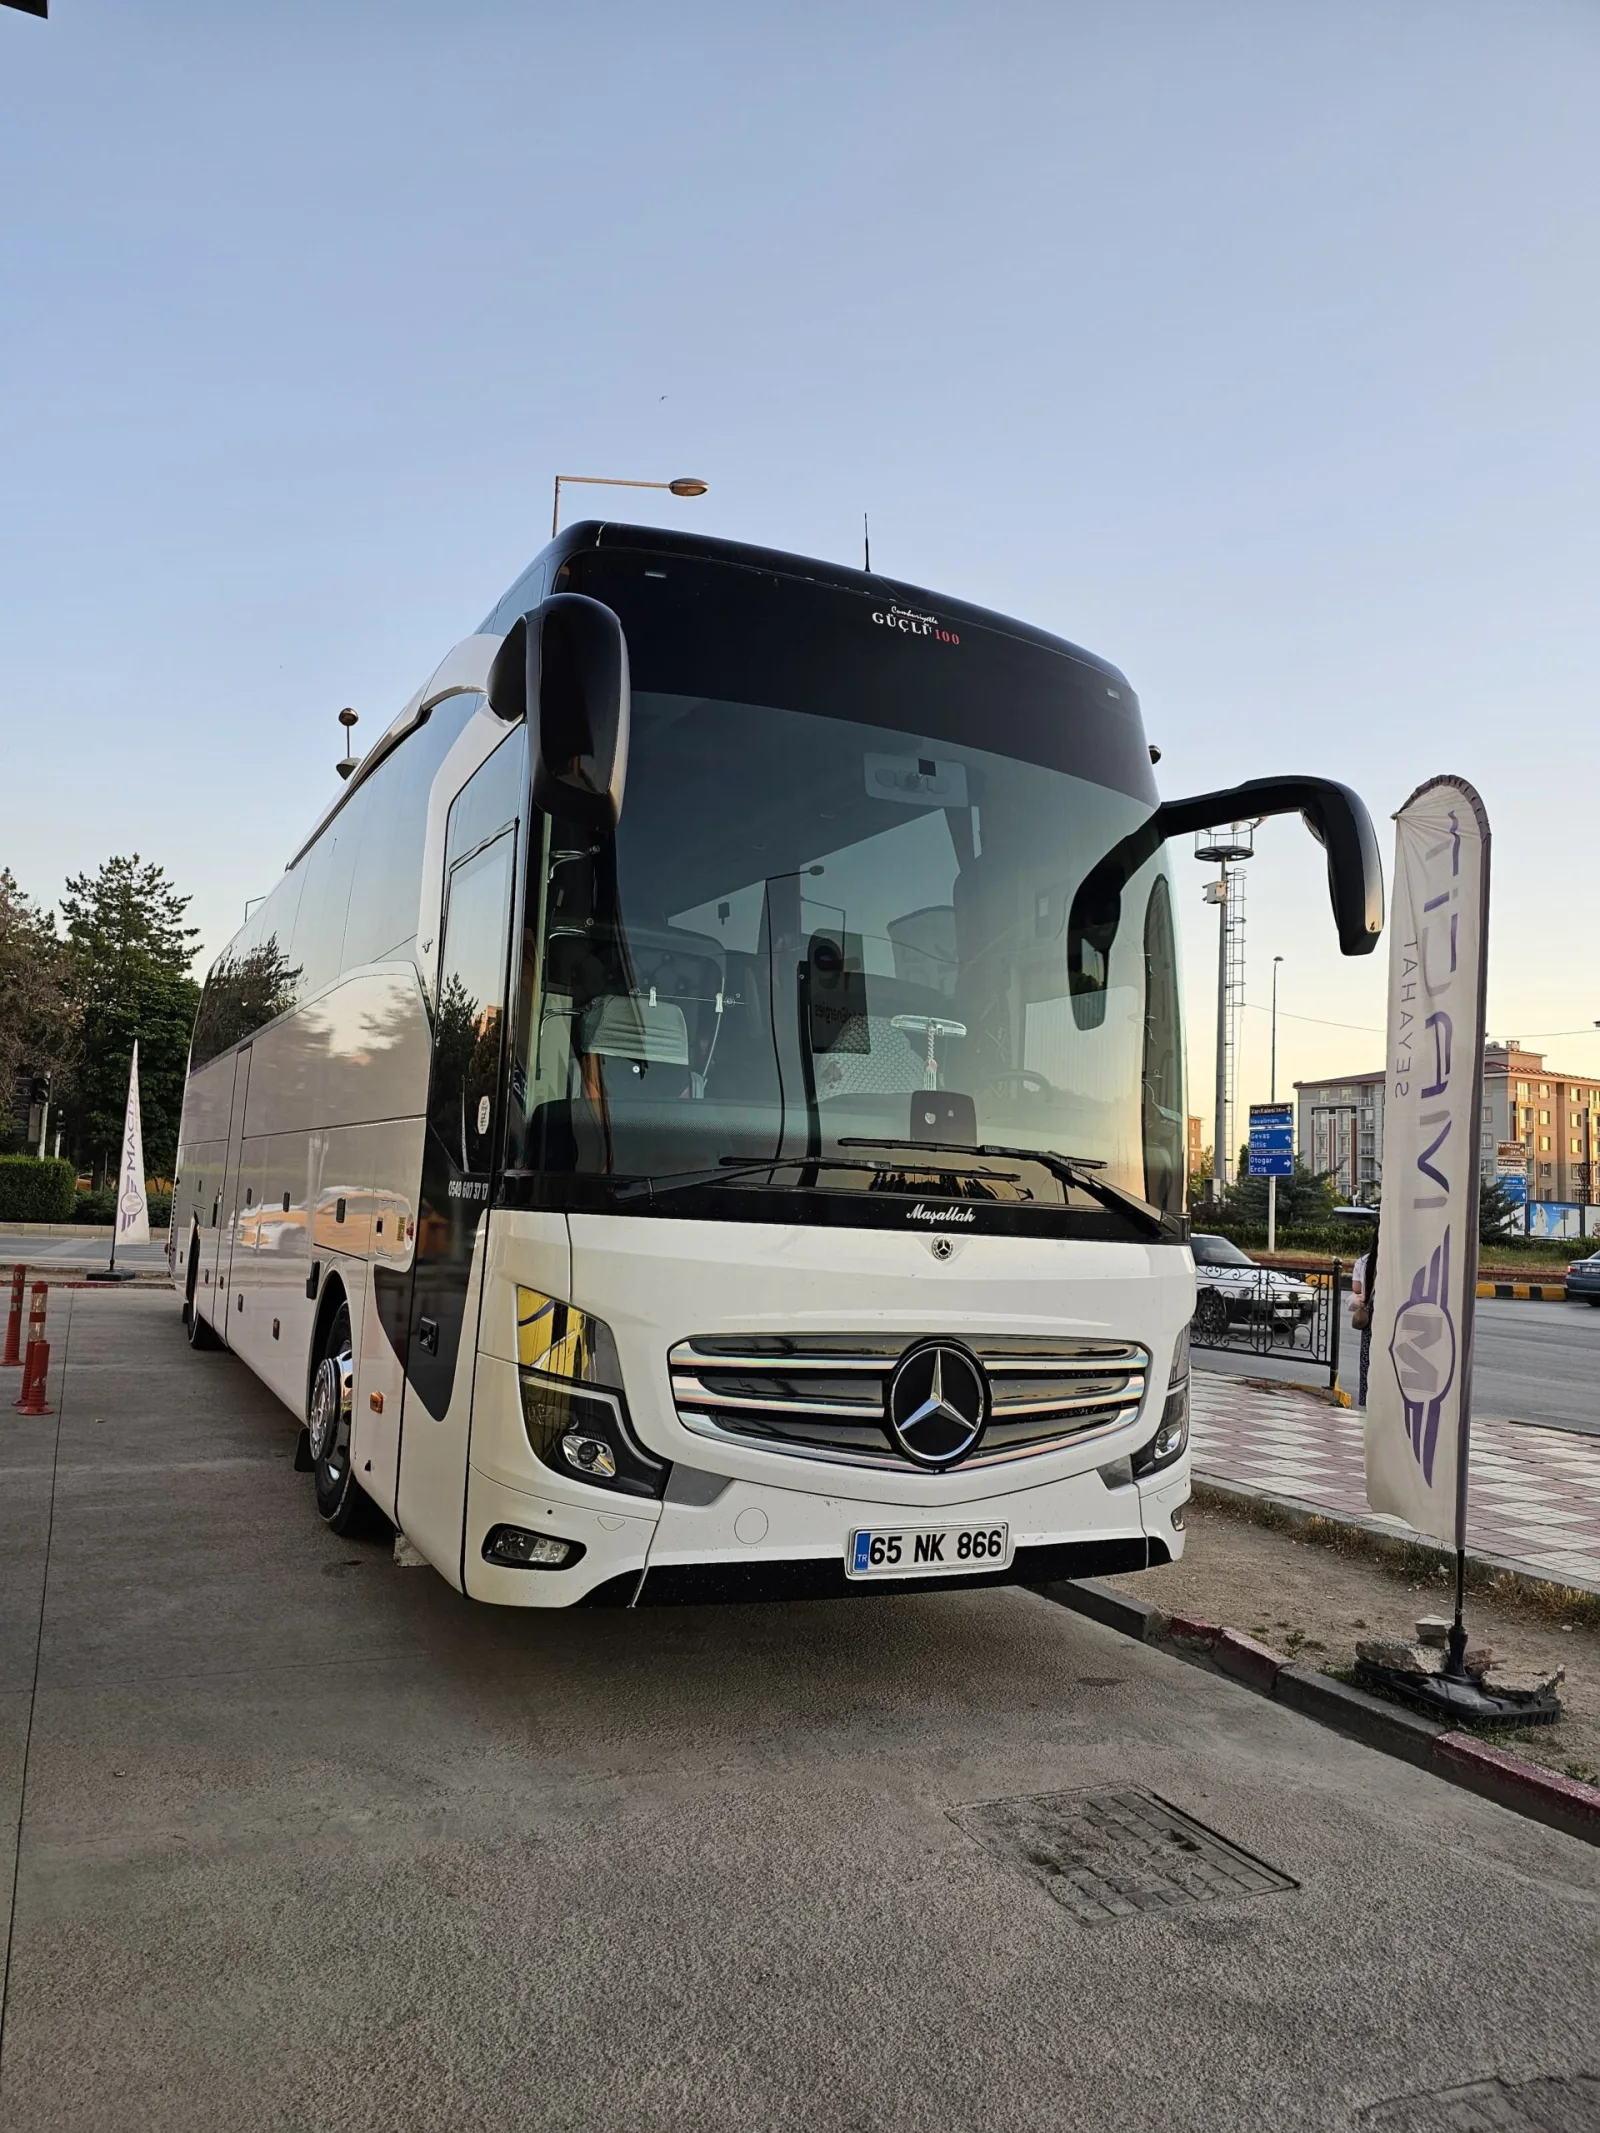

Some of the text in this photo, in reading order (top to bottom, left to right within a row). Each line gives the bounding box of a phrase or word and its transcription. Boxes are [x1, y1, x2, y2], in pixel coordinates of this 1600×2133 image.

[872, 612, 960, 645] GÜÇLÜ 100
[1250, 1156, 1274, 1165] Otogar
[906, 1203, 976, 1225] Maşallah
[857, 1530, 1002, 1565] TR 65 NK 866
